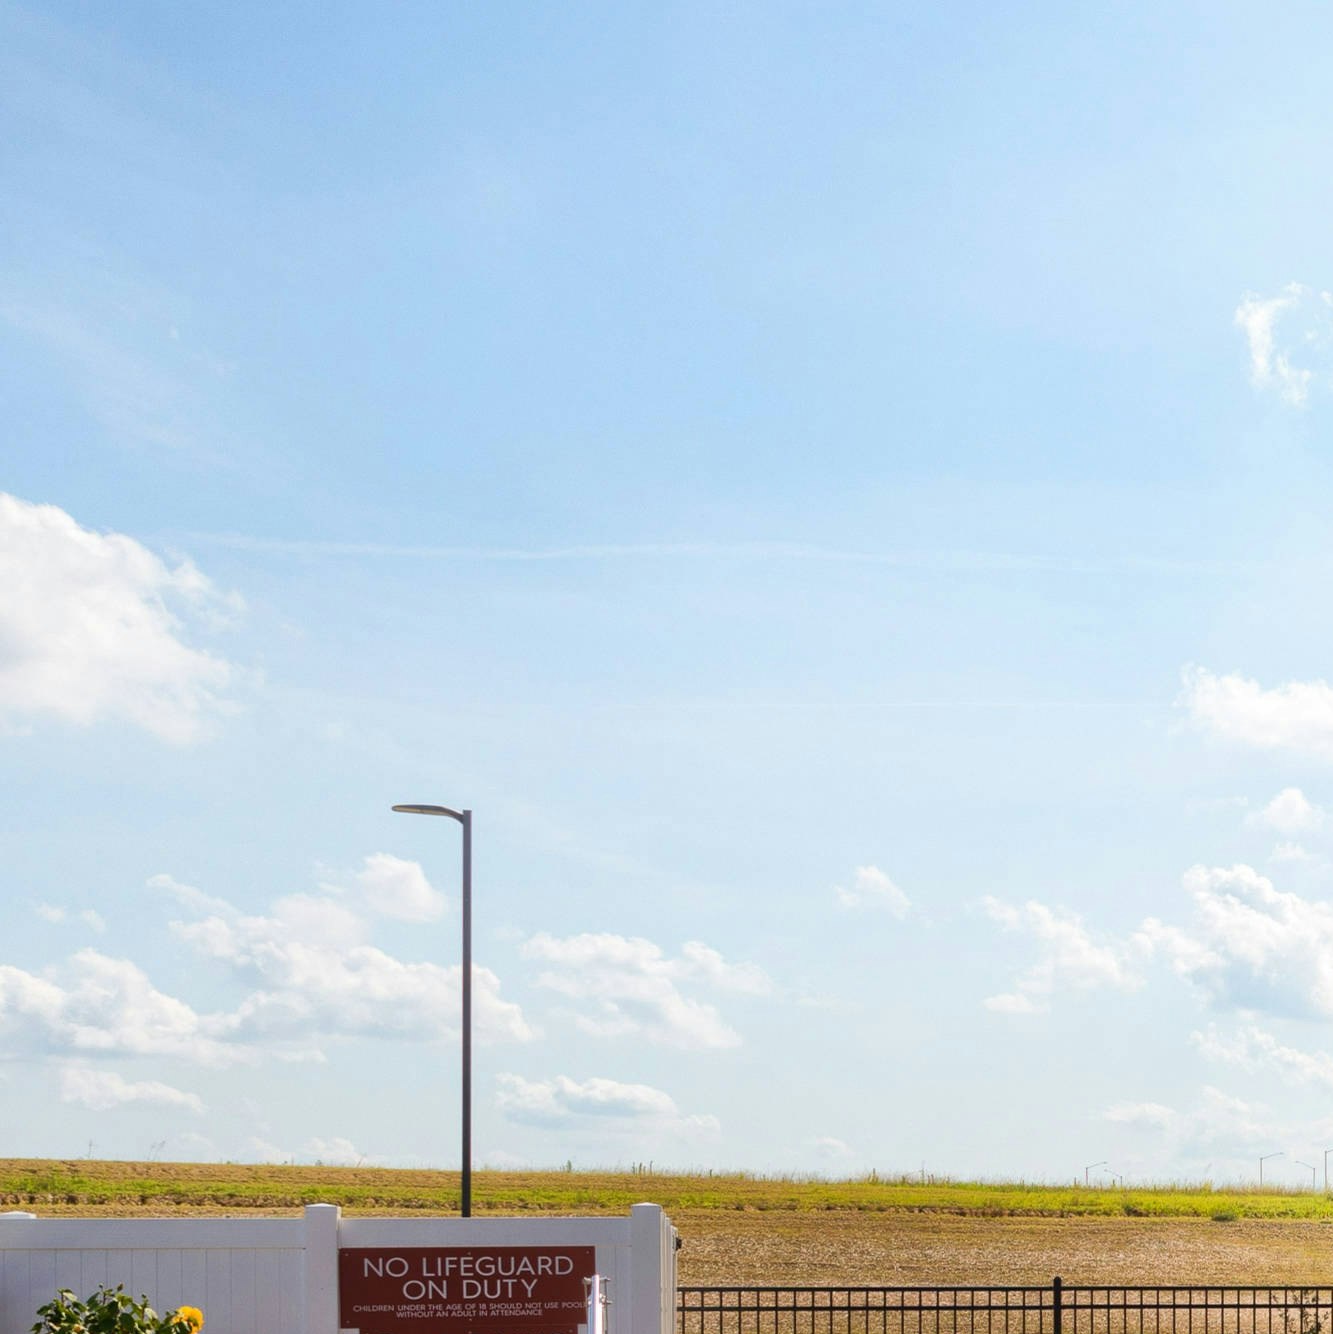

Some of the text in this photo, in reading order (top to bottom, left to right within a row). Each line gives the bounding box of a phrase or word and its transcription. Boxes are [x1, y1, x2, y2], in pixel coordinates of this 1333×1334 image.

[363, 1256, 574, 1278] NO LIFEGUARD
[403, 1279, 538, 1300] ON DUTY
[353, 1304, 395, 1312] CHILDREN
[427, 1303, 443, 1311] THE
